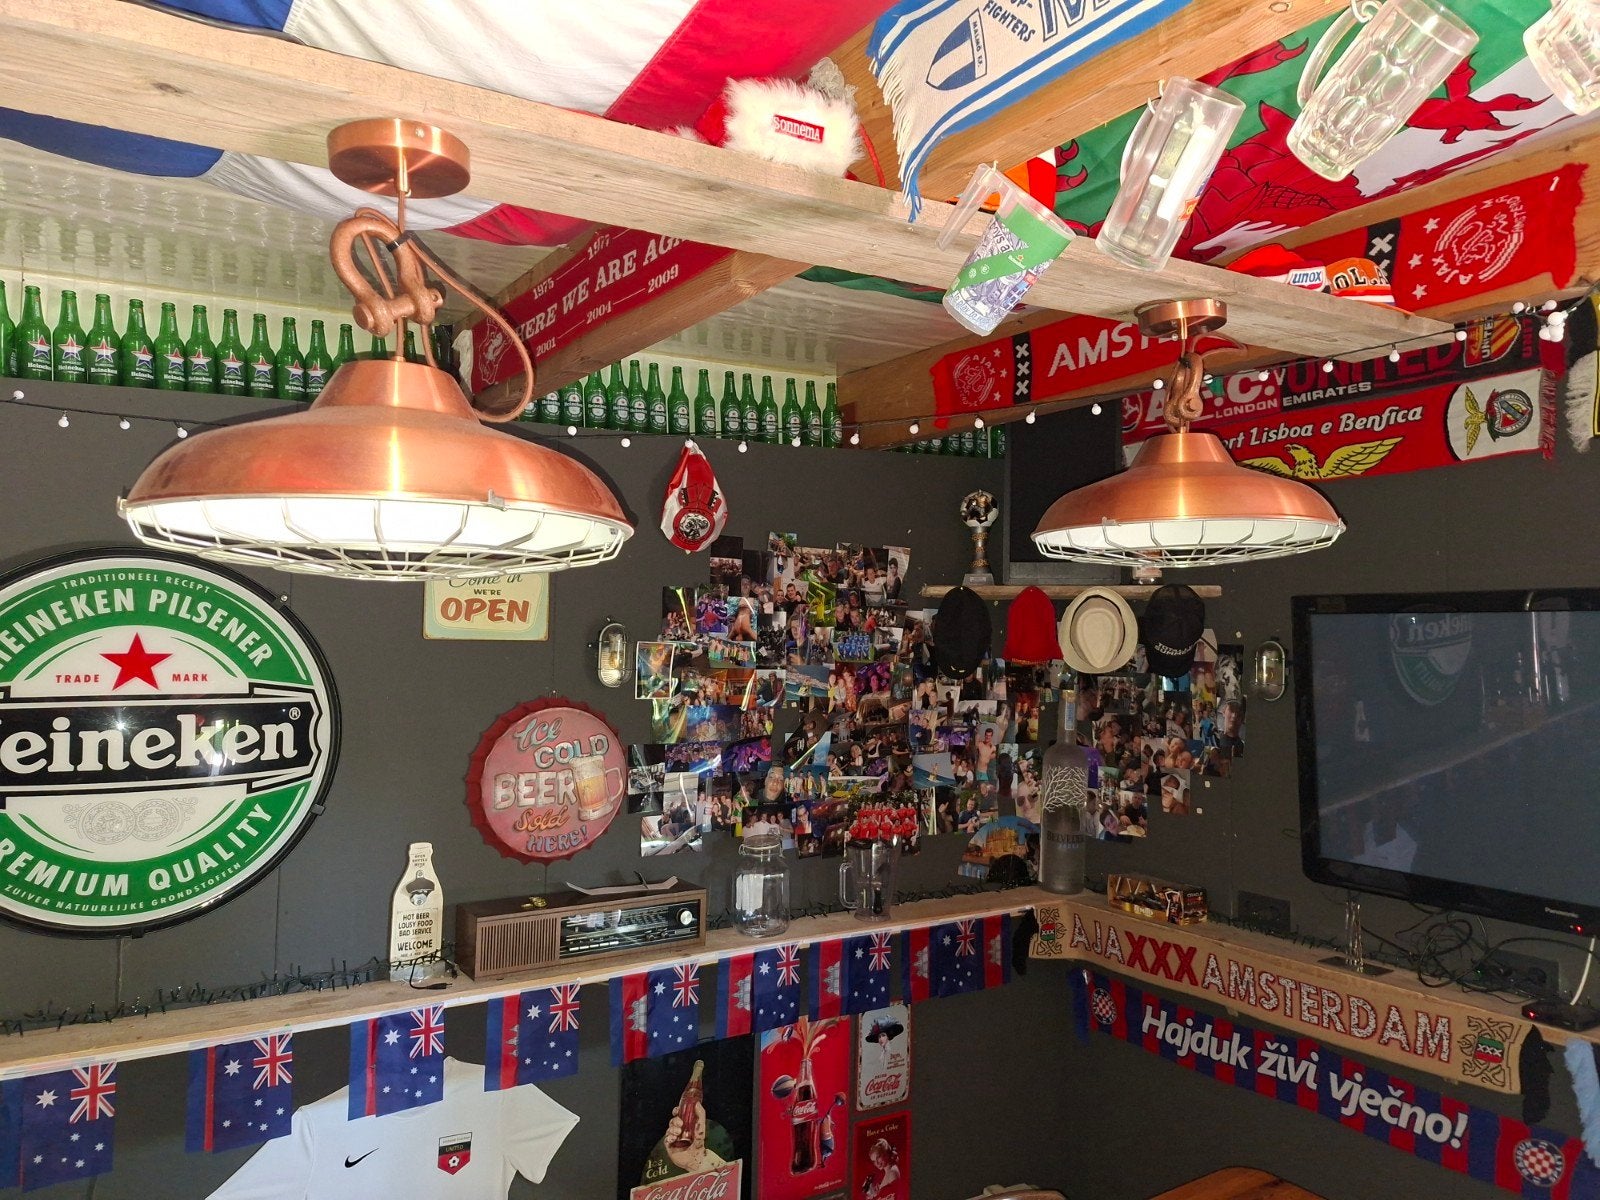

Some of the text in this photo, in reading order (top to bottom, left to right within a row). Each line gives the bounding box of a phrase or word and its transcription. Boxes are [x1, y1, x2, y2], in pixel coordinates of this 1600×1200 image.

[982, 0, 1036, 43] FIGHTERS
[533, 278, 555, 300] 1975
[562, 279, 590, 312] WE
[595, 251, 637, 293] ARE
[586, 301, 613, 324] 2004
[647, 264, 679, 294] 2009
[1215, 381, 1372, 420] LONDON EMIRATES
[1249, 421, 1313, 447] Lisboa
[1320, 421, 1333, 435] e
[1338, 405, 1423, 433] Benfica
[62, 572, 210, 594] TRADITIONEEL RECEPT
[149, 588, 274, 668] PILSENER
[440, 597, 530, 623] OPEN
[55, 672, 209, 684] TRADE MARK
[0, 713, 298, 774] eineken
[533, 734, 609, 769] COLD
[493, 770, 579, 810] BEER
[513, 805, 571, 833] Sold
[148, 802, 273, 891] QUALITY
[526, 824, 589, 853] HERE!
[5, 862, 241, 912] ZUIVER NATUURLIJKE GRONDSTOFFEN
[399, 926, 432, 937] BAD SERVICE
[402, 912, 430, 921] HOT BEER
[417, 919, 434, 927] FOOD
[397, 939, 433, 952] WELCOME
[1069, 913, 1453, 1064] AJAXXX AMSTERDAM
[1141, 1004, 1250, 1070] Hajduk
[1257, 1040, 1320, 1091] živi
[1329, 1070, 1470, 1150] vječno!
[645, 1165, 669, 1180] Cold
